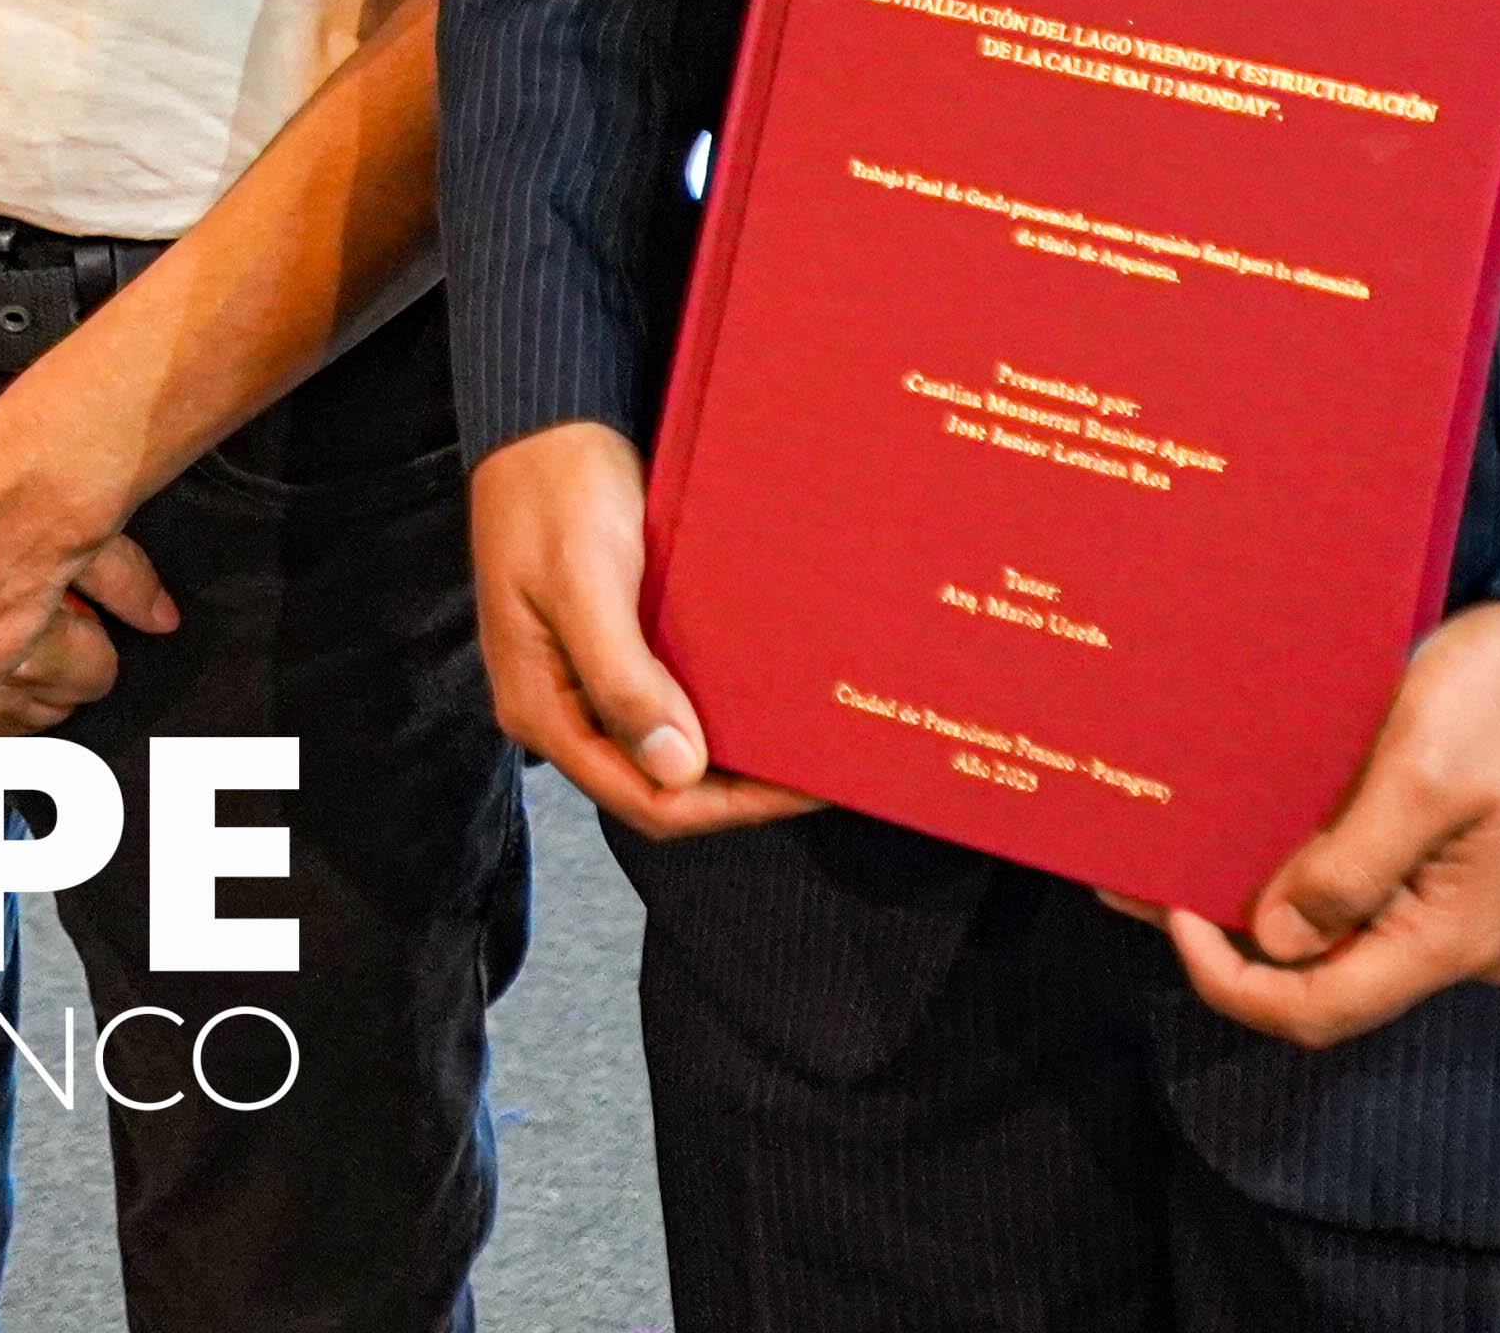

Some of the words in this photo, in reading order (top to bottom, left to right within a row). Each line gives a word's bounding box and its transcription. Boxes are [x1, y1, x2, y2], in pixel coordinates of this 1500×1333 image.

[981, 36, 1012, 60] DE
[1012, 44, 1043, 67] LA
[1043, 52, 1111, 82] CALLE
[1110, 65, 1150, 91] KM
[1152, 76, 1175, 97] 12
[1028, 16, 1071, 42] DEL
[1070, 26, 1133, 55] LAGO
[1219, 57, 1239, 79] Y
[1238, 60, 1438, 122] ESTRUCTURACIÓN
